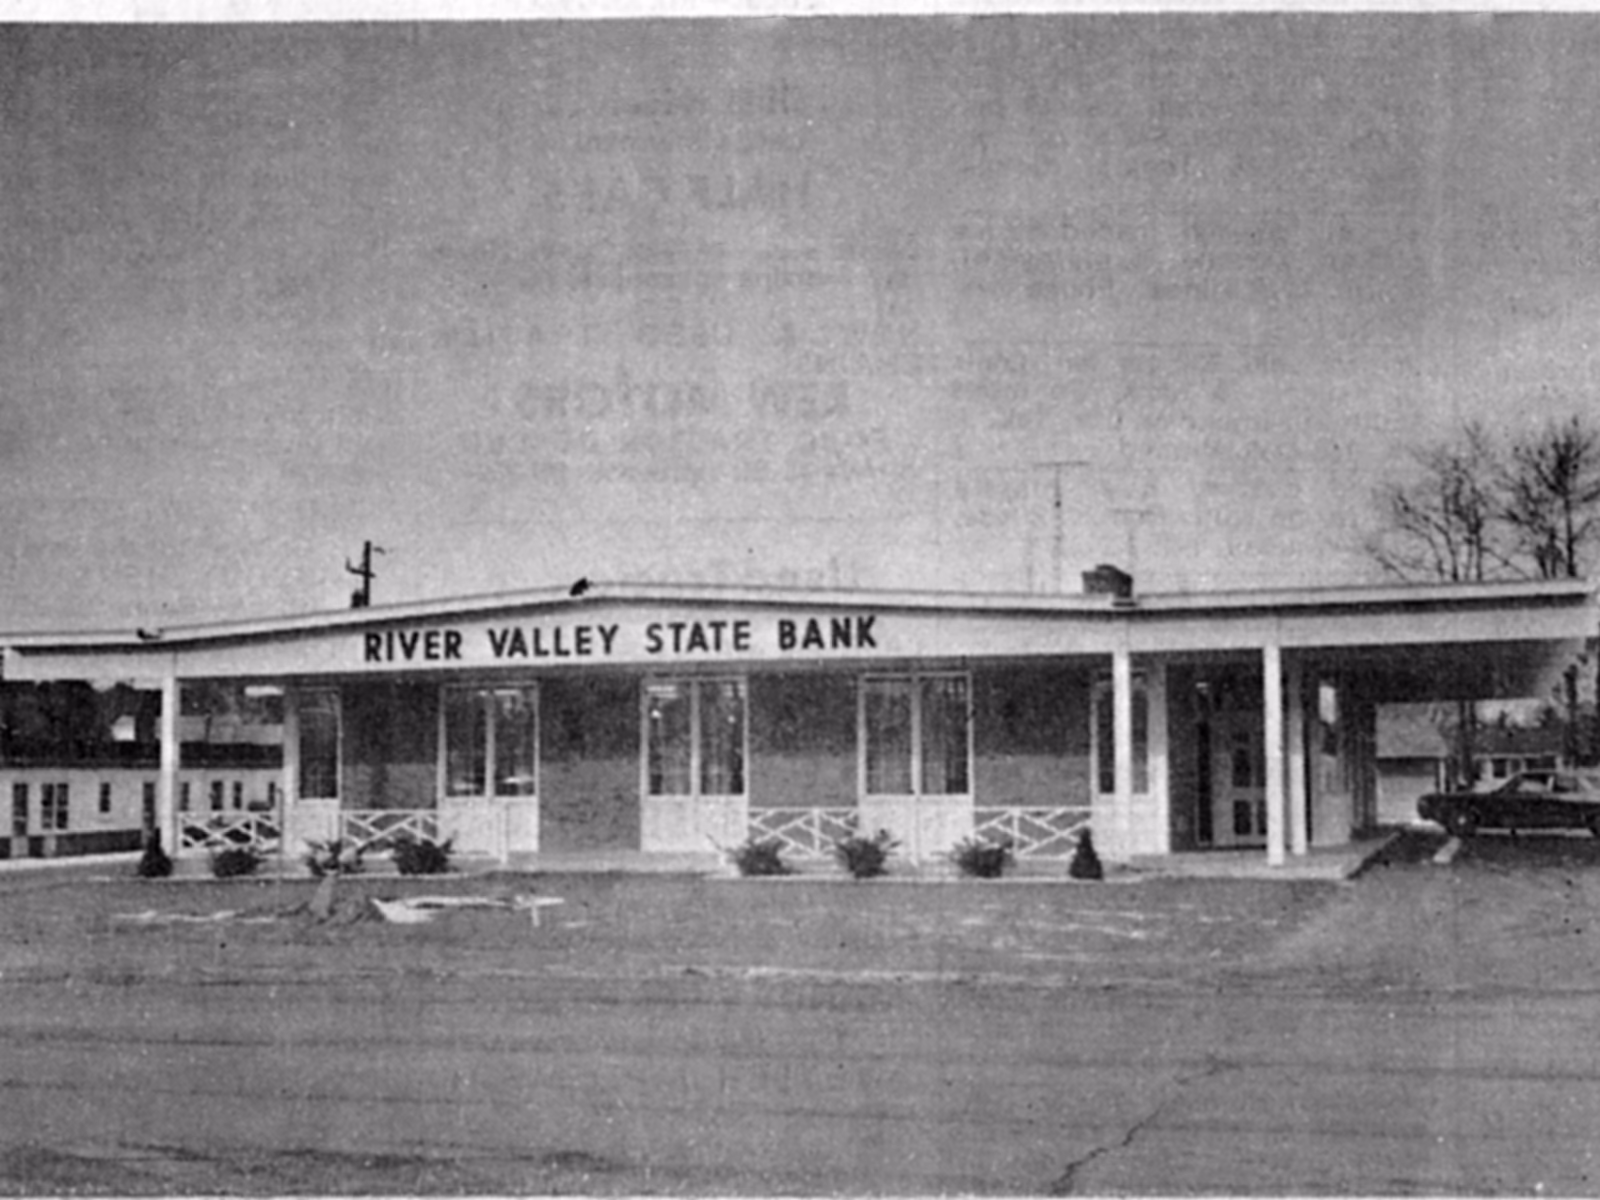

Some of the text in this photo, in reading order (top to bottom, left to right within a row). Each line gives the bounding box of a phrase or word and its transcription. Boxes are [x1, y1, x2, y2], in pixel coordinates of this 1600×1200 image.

[365, 615, 878, 661] RIVER VALLEY STATE BANK
